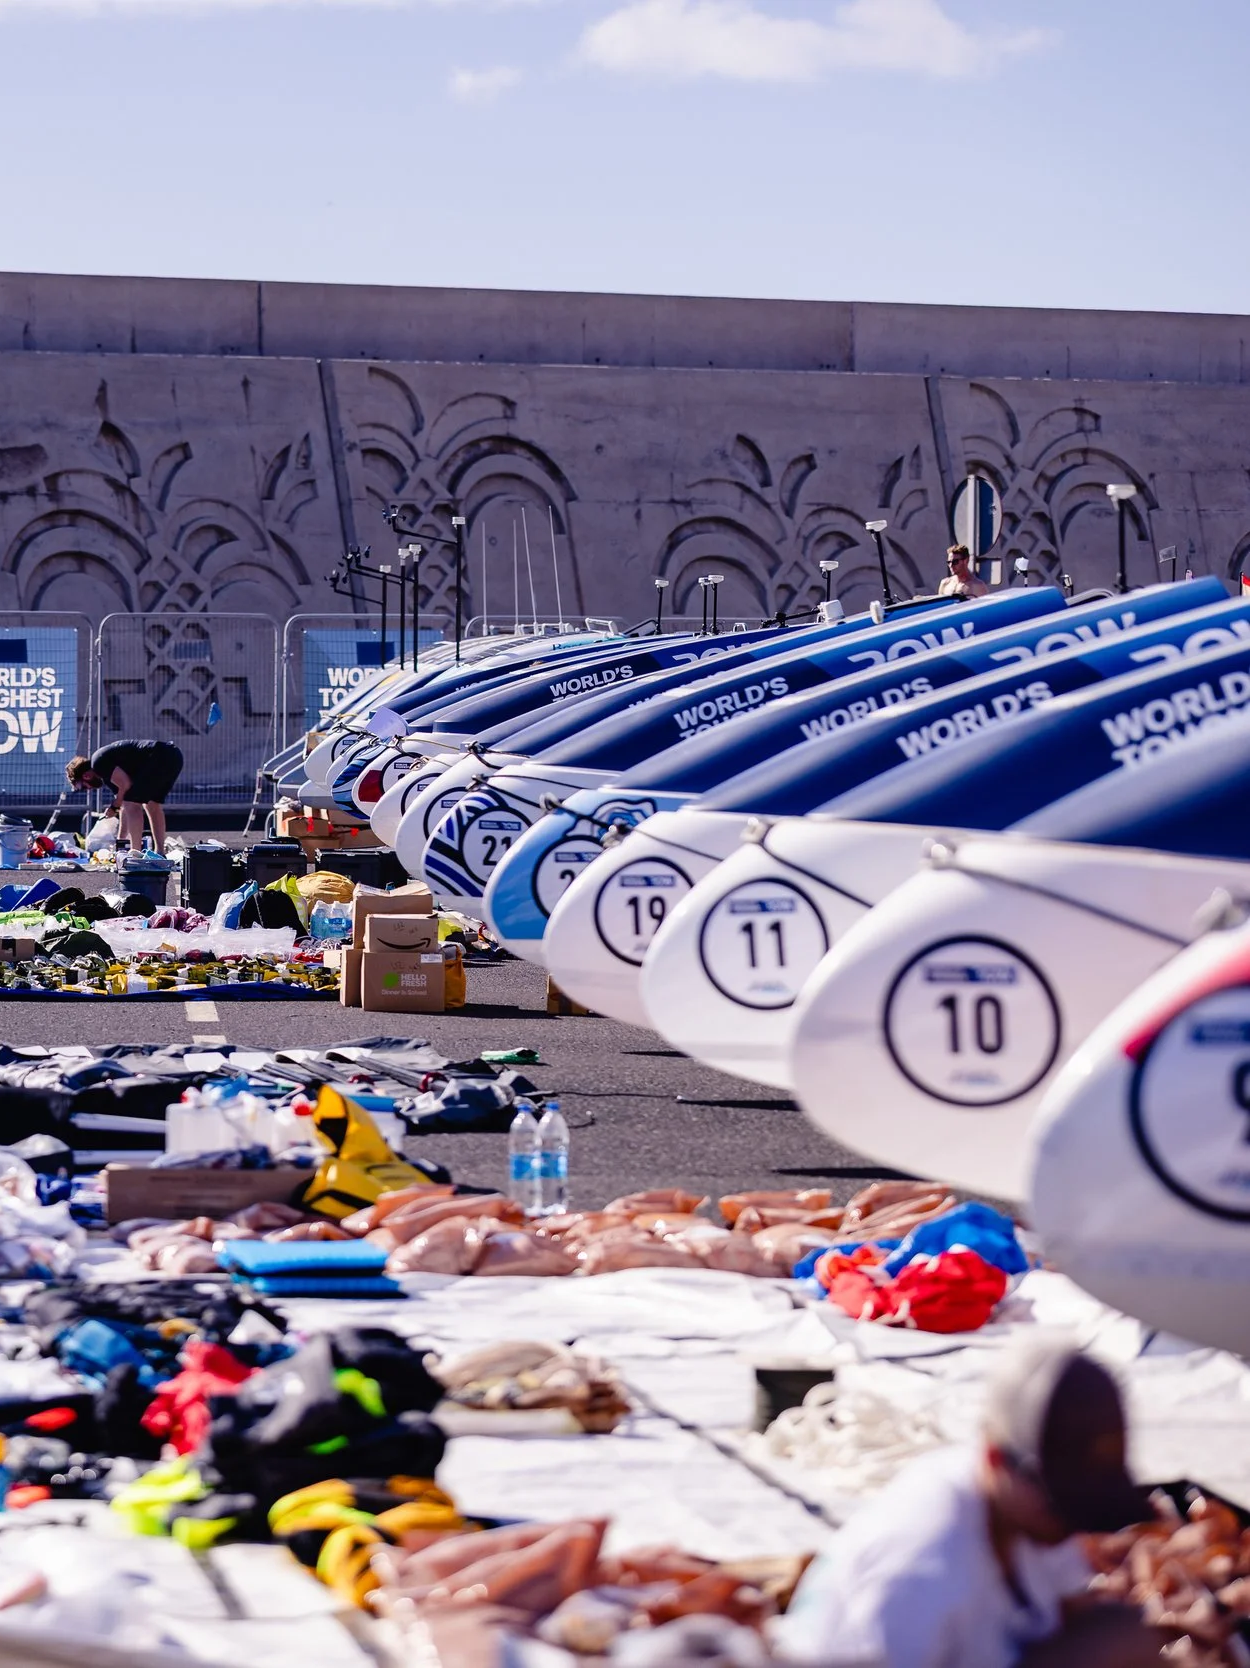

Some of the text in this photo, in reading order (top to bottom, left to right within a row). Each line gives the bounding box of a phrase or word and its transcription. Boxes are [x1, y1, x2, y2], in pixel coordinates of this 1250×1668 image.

[550, 665, 634, 697] WORLD'S
[674, 677, 789, 730] WORLD'S
[896, 681, 1054, 759] WORLD'S
[1101, 671, 1250, 748] WORLD
[626, 895, 666, 936] 19
[739, 920, 786, 968] 11
[937, 993, 1004, 1054] 10
